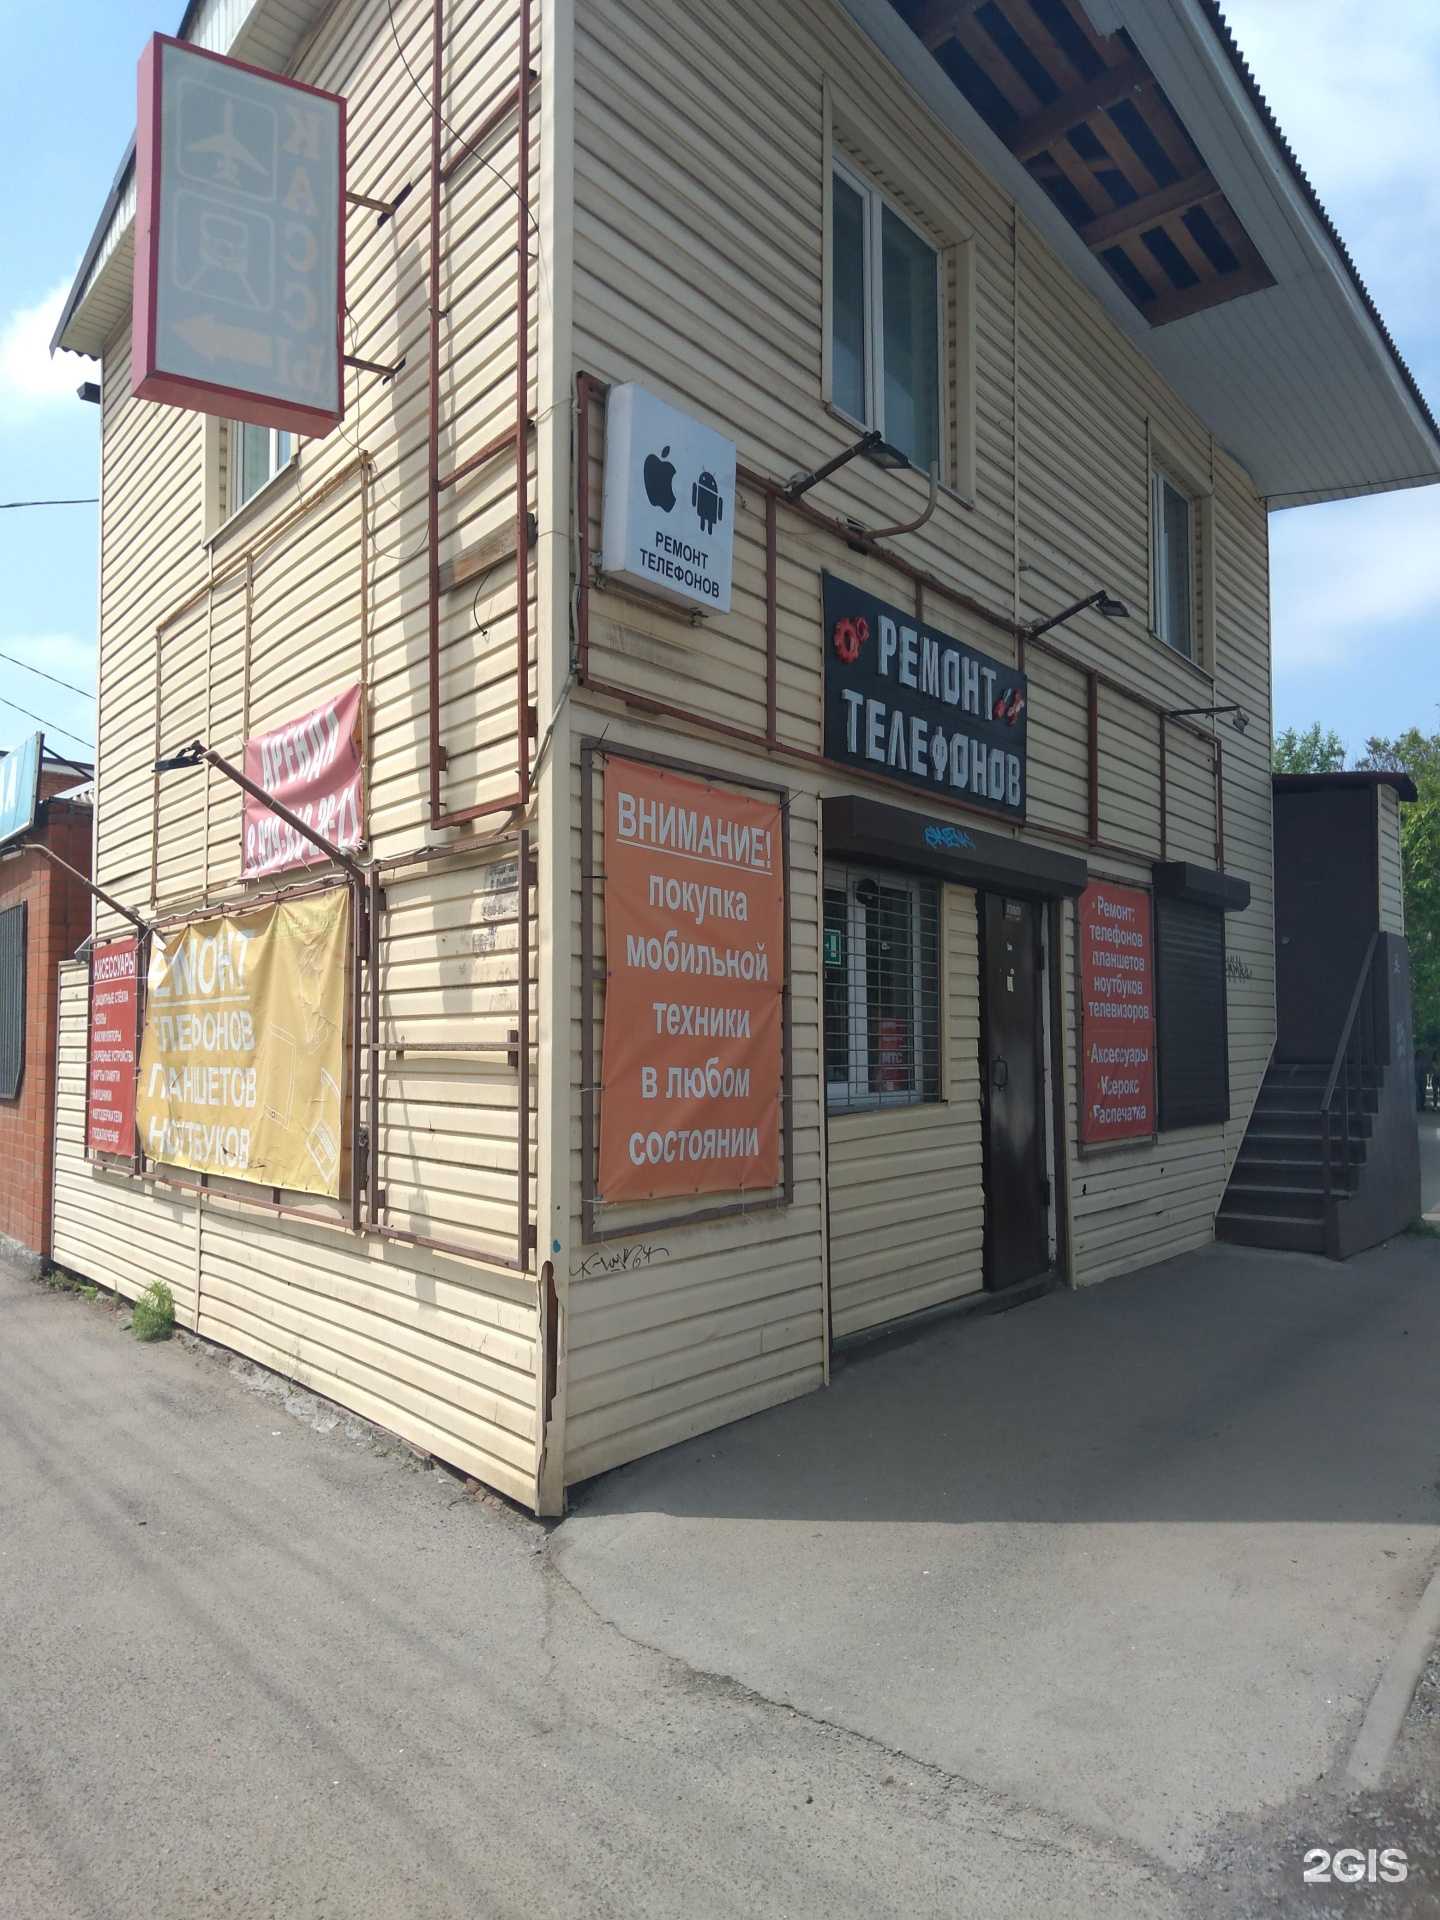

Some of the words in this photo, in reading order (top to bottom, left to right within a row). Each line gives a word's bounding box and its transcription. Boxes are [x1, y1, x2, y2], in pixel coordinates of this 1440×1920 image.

[655, 530, 709, 570] РЕМОНТ
[639, 548, 721, 599] ТЕЛЕФОНОВ
[877, 615, 997, 721] РЕМОНТ
[841, 688, 1022, 807] ТЕЛЕФОНОВ
[617, 791, 772, 869] ВНИМАНИЕ!
[649, 873, 748, 925] покупка
[626, 929, 769, 982] мобильной
[1089, 924, 1143, 949] телефонов
[1092, 951, 1145, 971] планшетов
[1093, 973, 1143, 998] ноутбуков
[653, 1002, 751, 1038] техники
[1088, 1001, 1149, 1023] телевизоров
[665, 1057, 750, 1099] любом
[628, 1127, 759, 1166] состоянии
